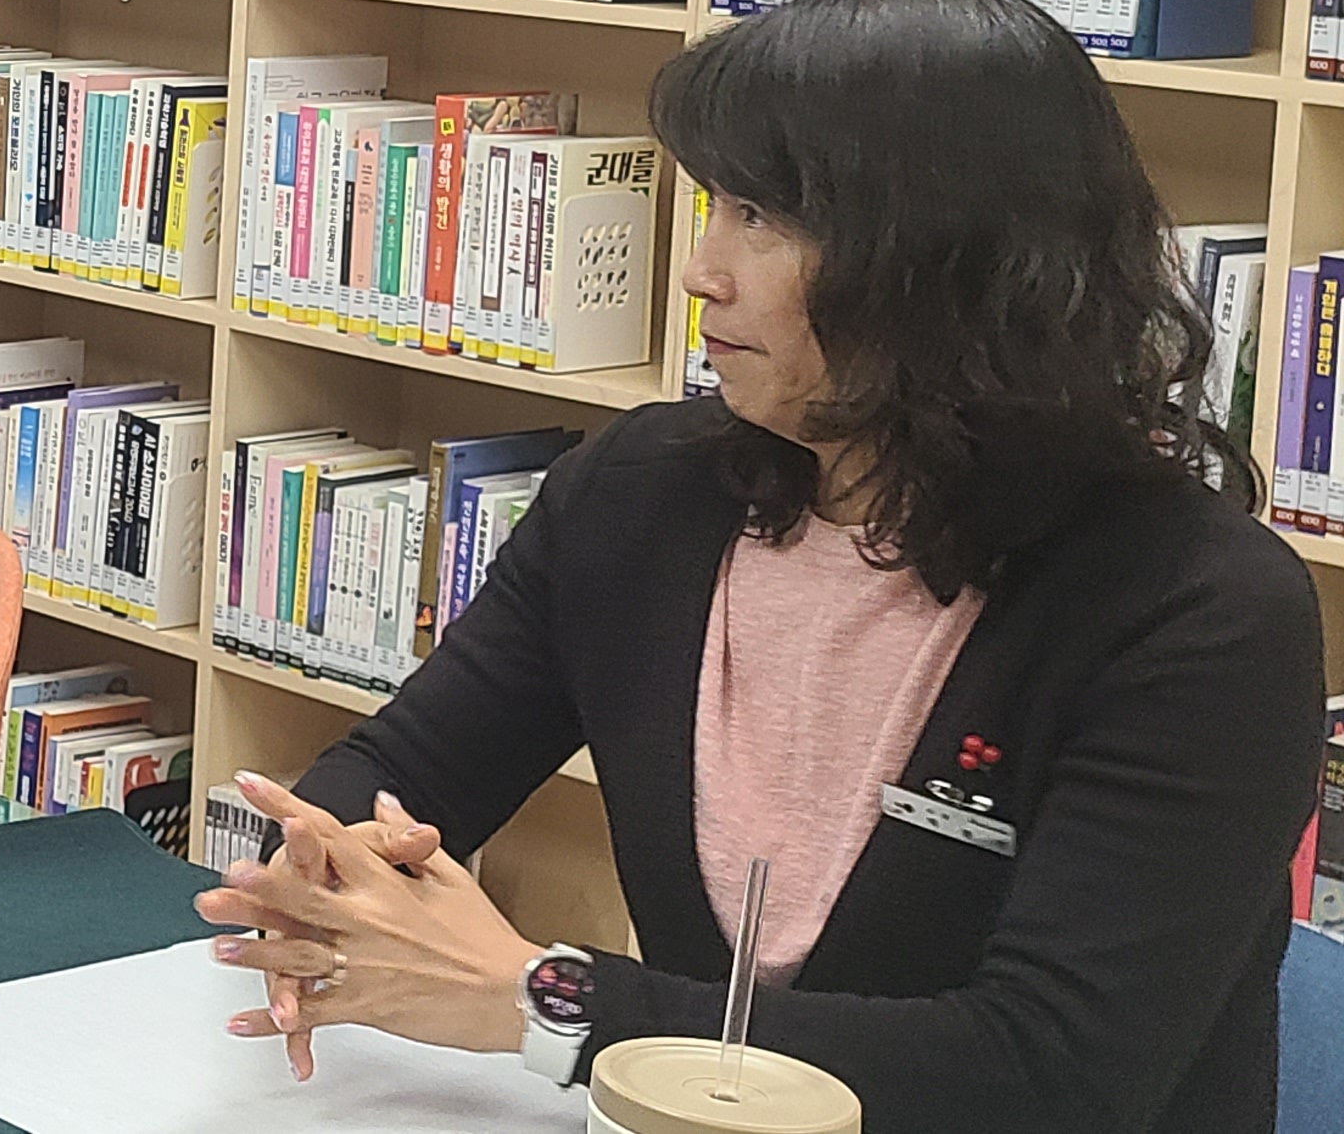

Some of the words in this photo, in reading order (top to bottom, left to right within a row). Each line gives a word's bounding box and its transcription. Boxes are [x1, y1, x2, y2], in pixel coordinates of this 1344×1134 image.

[12, 79, 22, 113] 거인의
[10, 115, 20, 171] 포트폴리오
[587, 150, 655, 186] 군대를
[144, 434, 156, 447] AI
[138, 449, 154, 518] 소사이어티
